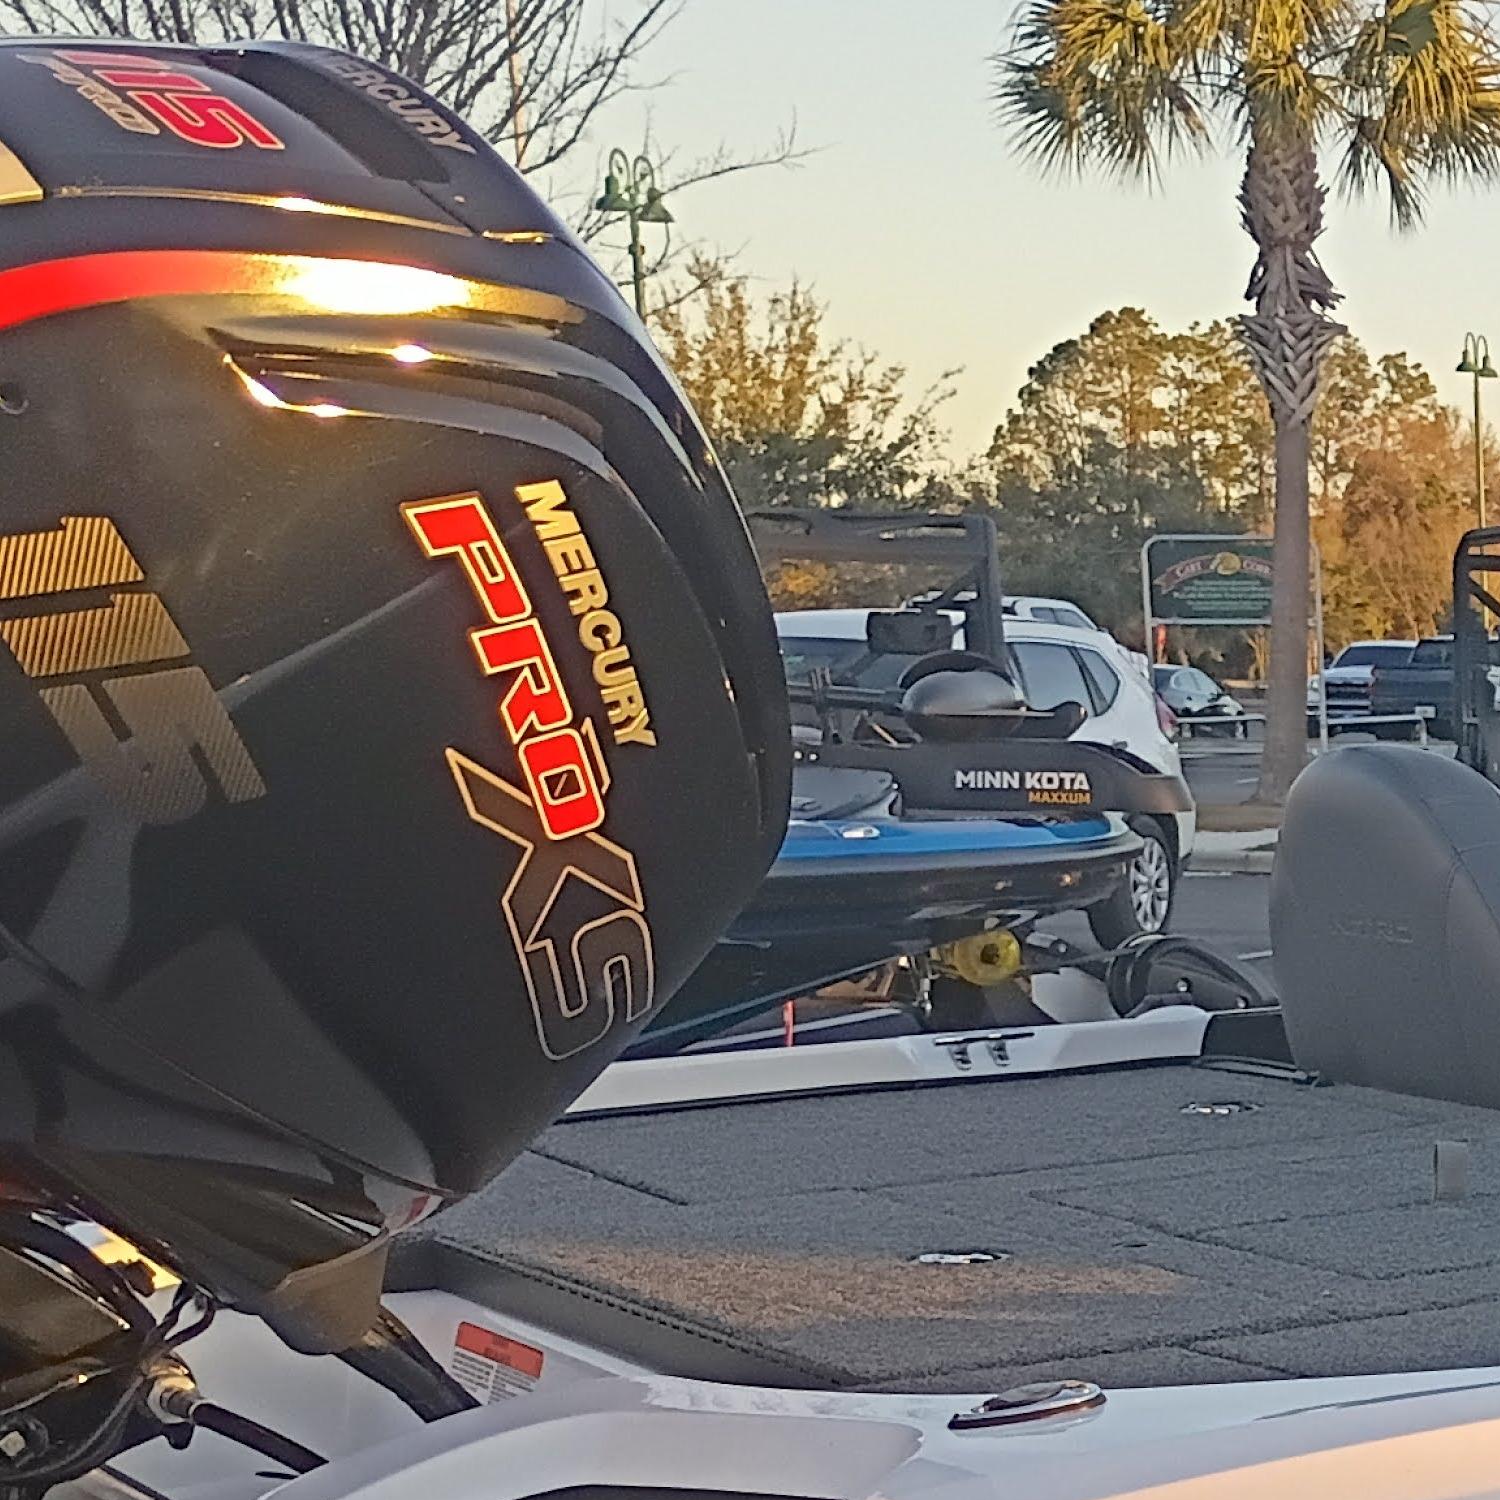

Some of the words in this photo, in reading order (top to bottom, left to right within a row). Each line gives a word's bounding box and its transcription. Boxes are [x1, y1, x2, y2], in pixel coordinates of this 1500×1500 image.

[51, 50, 286, 150] 115
[0, 516, 267, 826] 115
[400, 491, 606, 841] PRO
[514, 479, 657, 746] MERCURY
[445, 717, 657, 1062] XS
[954, 770, 1021, 790] MINN
[1024, 771, 1091, 791] KOTA
[1028, 791, 1093, 805] MAXXUM
